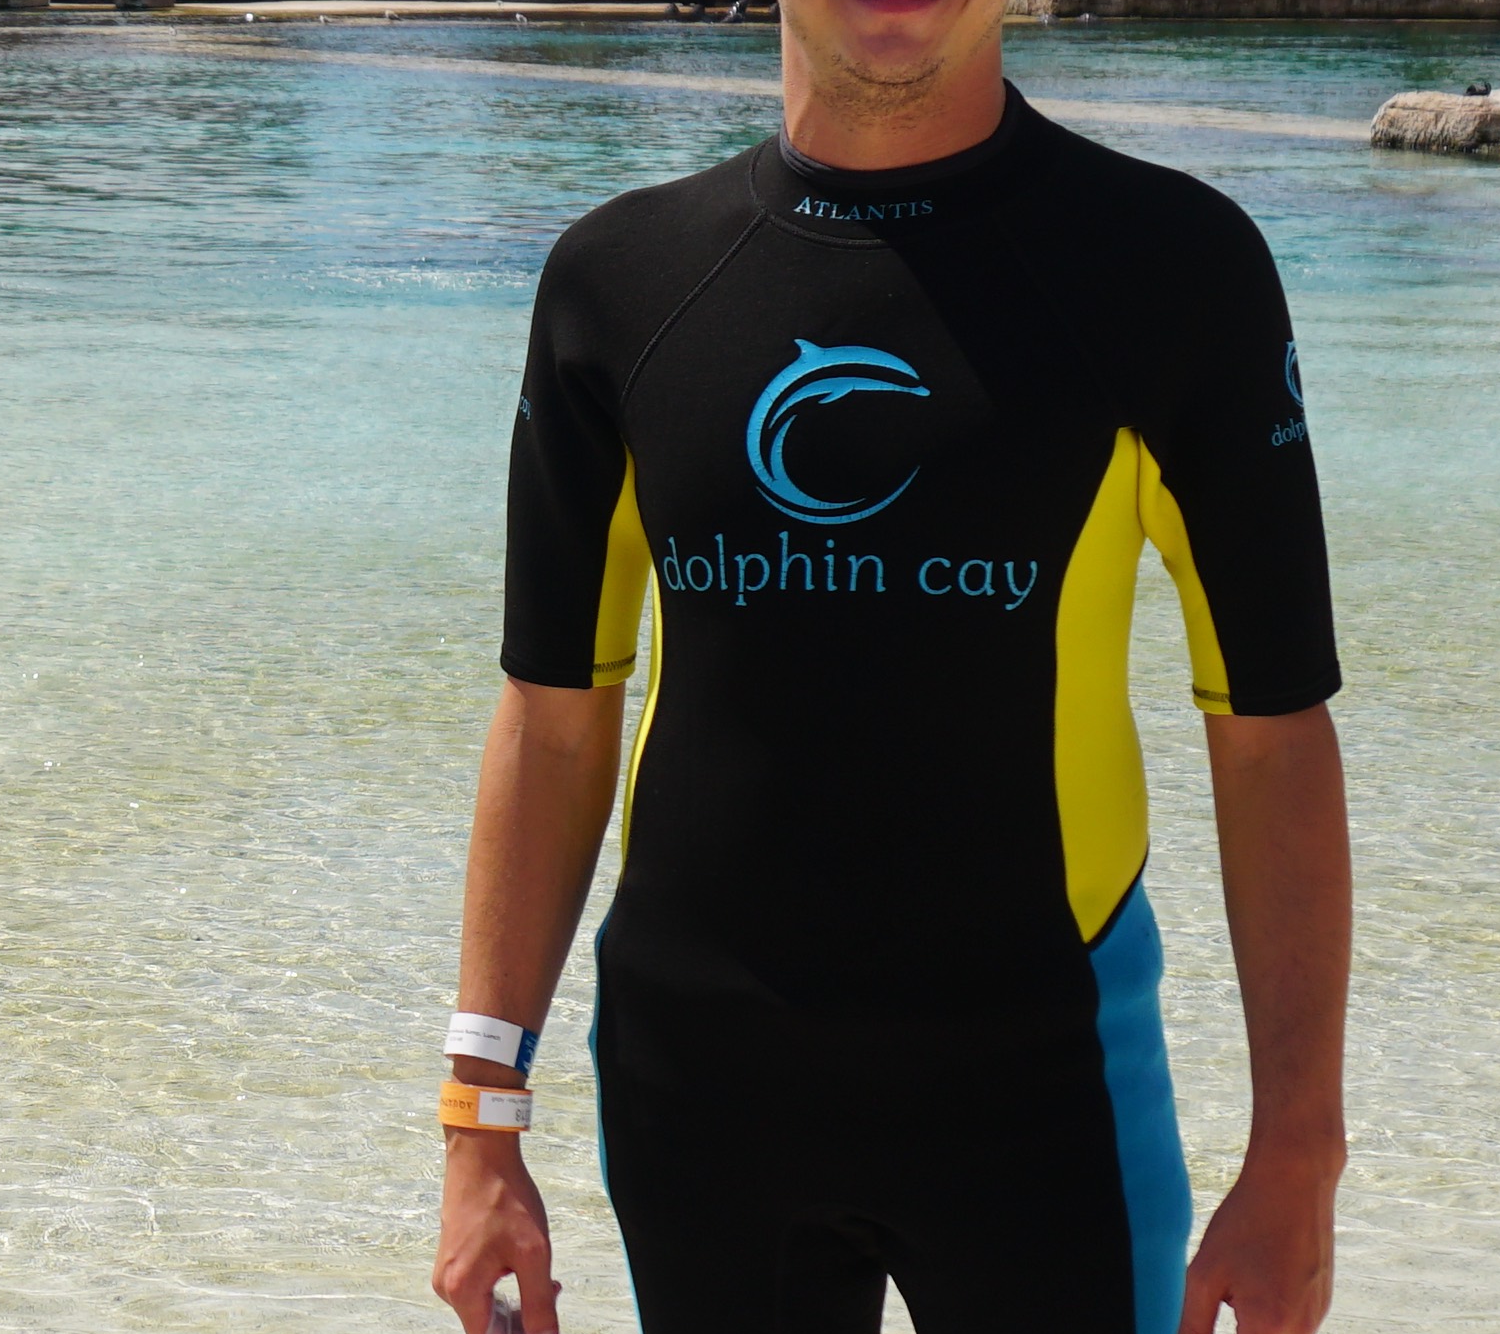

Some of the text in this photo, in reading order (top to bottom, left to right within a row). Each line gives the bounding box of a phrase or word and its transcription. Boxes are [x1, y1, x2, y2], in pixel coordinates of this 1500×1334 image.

[793, 196, 933, 221] ATLANTIS
[1271, 416, 1305, 446] dolp
[663, 531, 1038, 611] dolphin cay
